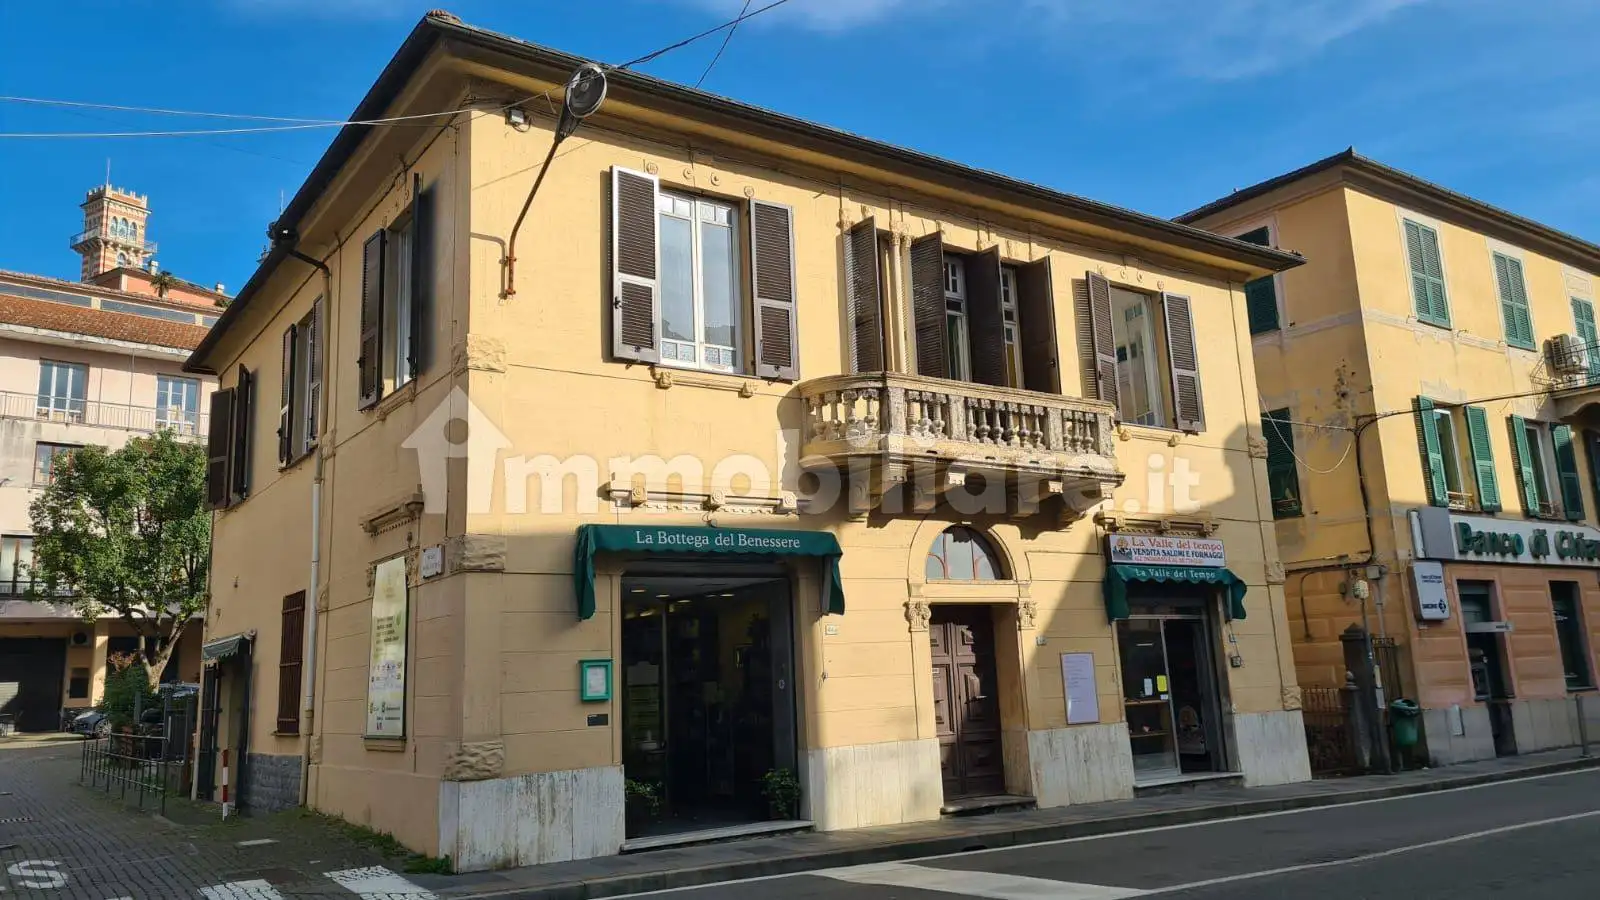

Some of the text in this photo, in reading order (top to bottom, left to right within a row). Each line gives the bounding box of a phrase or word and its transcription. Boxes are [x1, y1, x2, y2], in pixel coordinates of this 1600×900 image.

[636, 531, 800, 548] La Bottega del Benessere
[1132, 537, 1222, 552] La Valle del tempo
[1455, 522, 1600, 560] Banco di Chia
[1133, 547, 1160, 557] VENDITA
[1192, 550, 1224, 560] FORMAGGI
[1135, 568, 1216, 580] La Valle del Tempo
